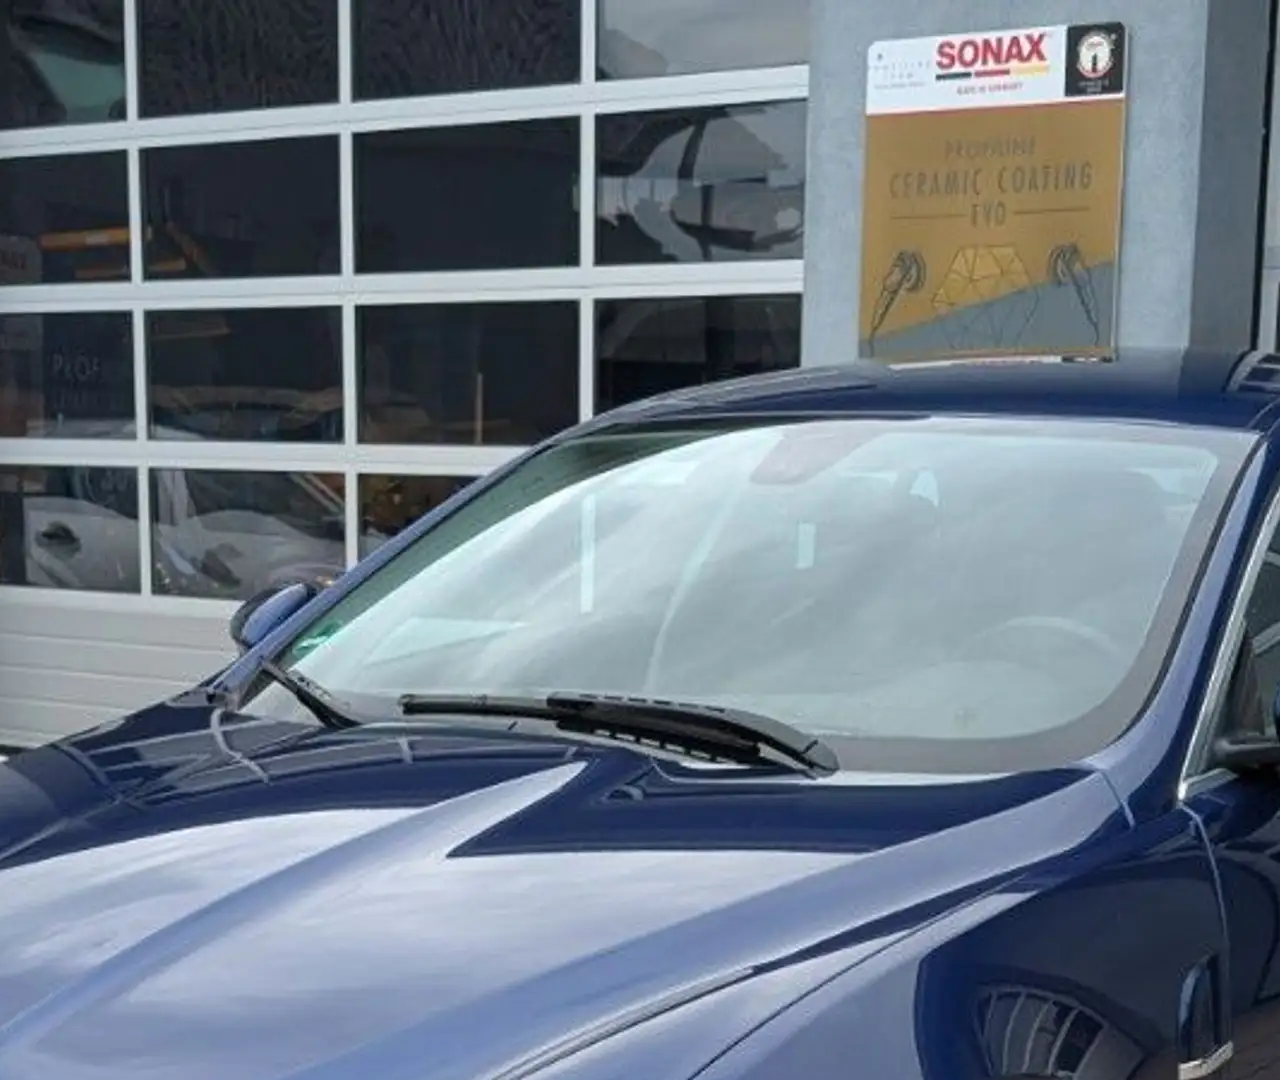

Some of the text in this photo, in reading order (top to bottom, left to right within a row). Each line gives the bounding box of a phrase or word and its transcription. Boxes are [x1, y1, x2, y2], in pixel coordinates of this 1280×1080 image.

[935, 32, 1047, 70] SONAX
[889, 160, 1093, 200] CERAMIC COATING
